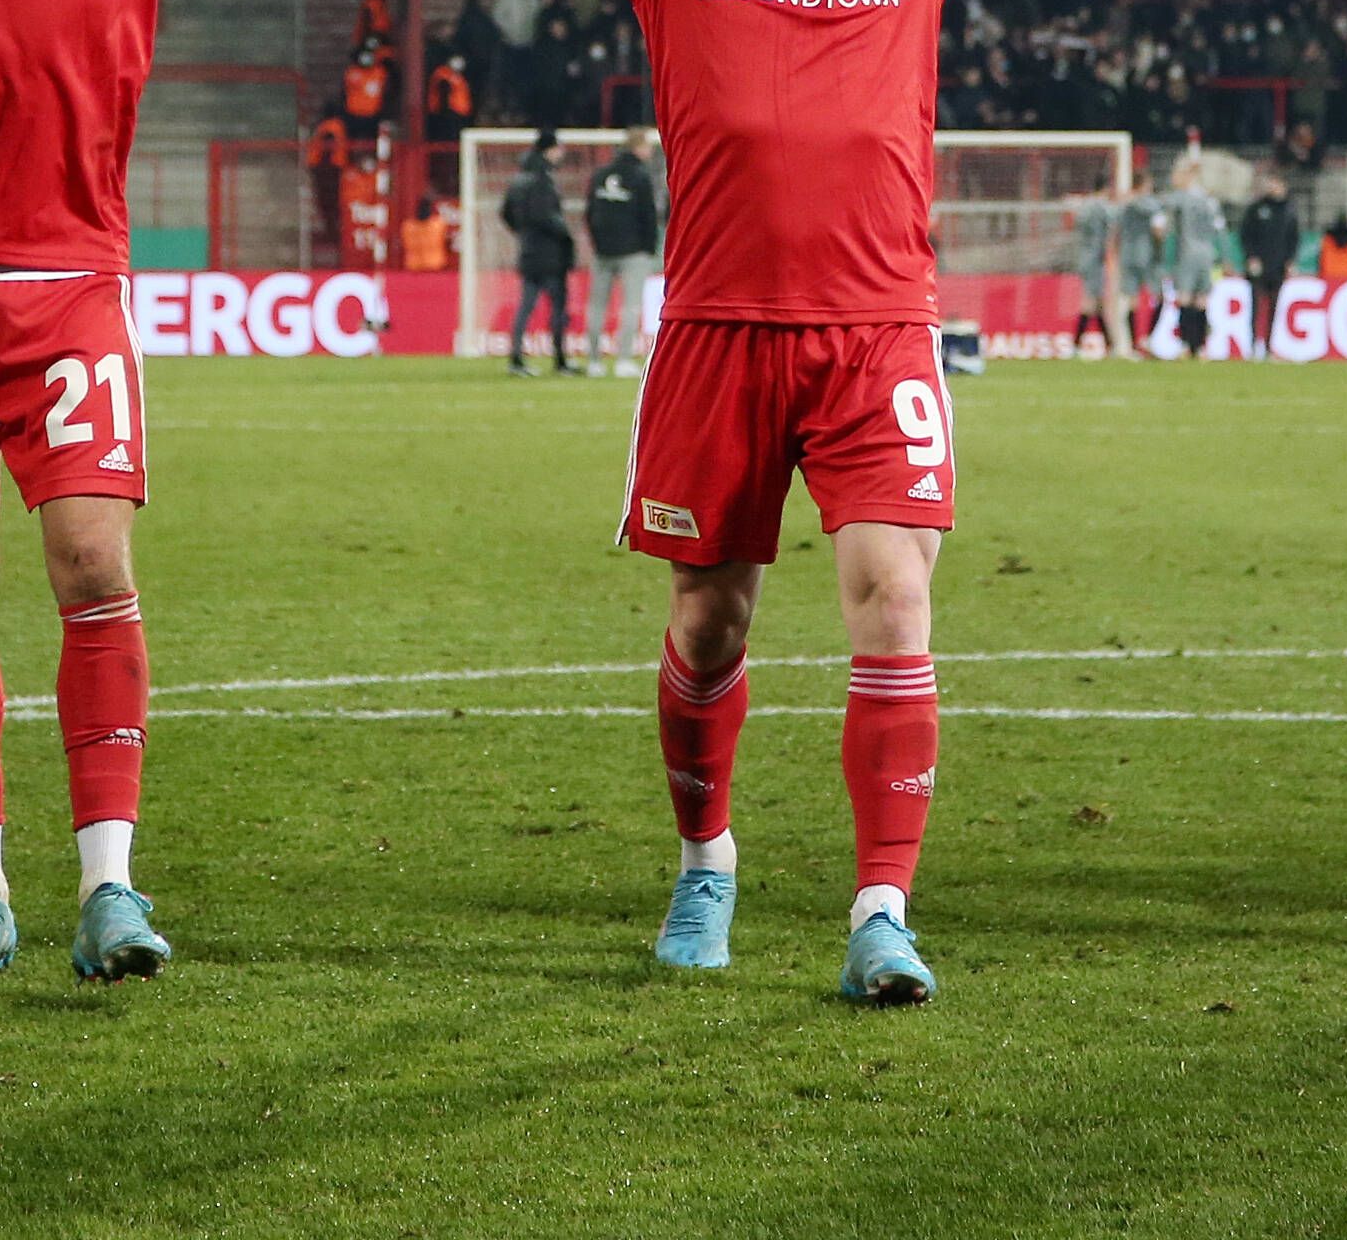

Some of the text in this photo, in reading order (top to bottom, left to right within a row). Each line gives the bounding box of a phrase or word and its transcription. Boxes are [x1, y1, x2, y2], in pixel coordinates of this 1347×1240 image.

[132, 271, 389, 358] ERGO
[45, 353, 132, 449] 21
[892, 378, 947, 468] 9
[98, 459, 135, 473] adidas
[907, 488, 943, 502] adidas
[890, 780, 934, 799] adid
